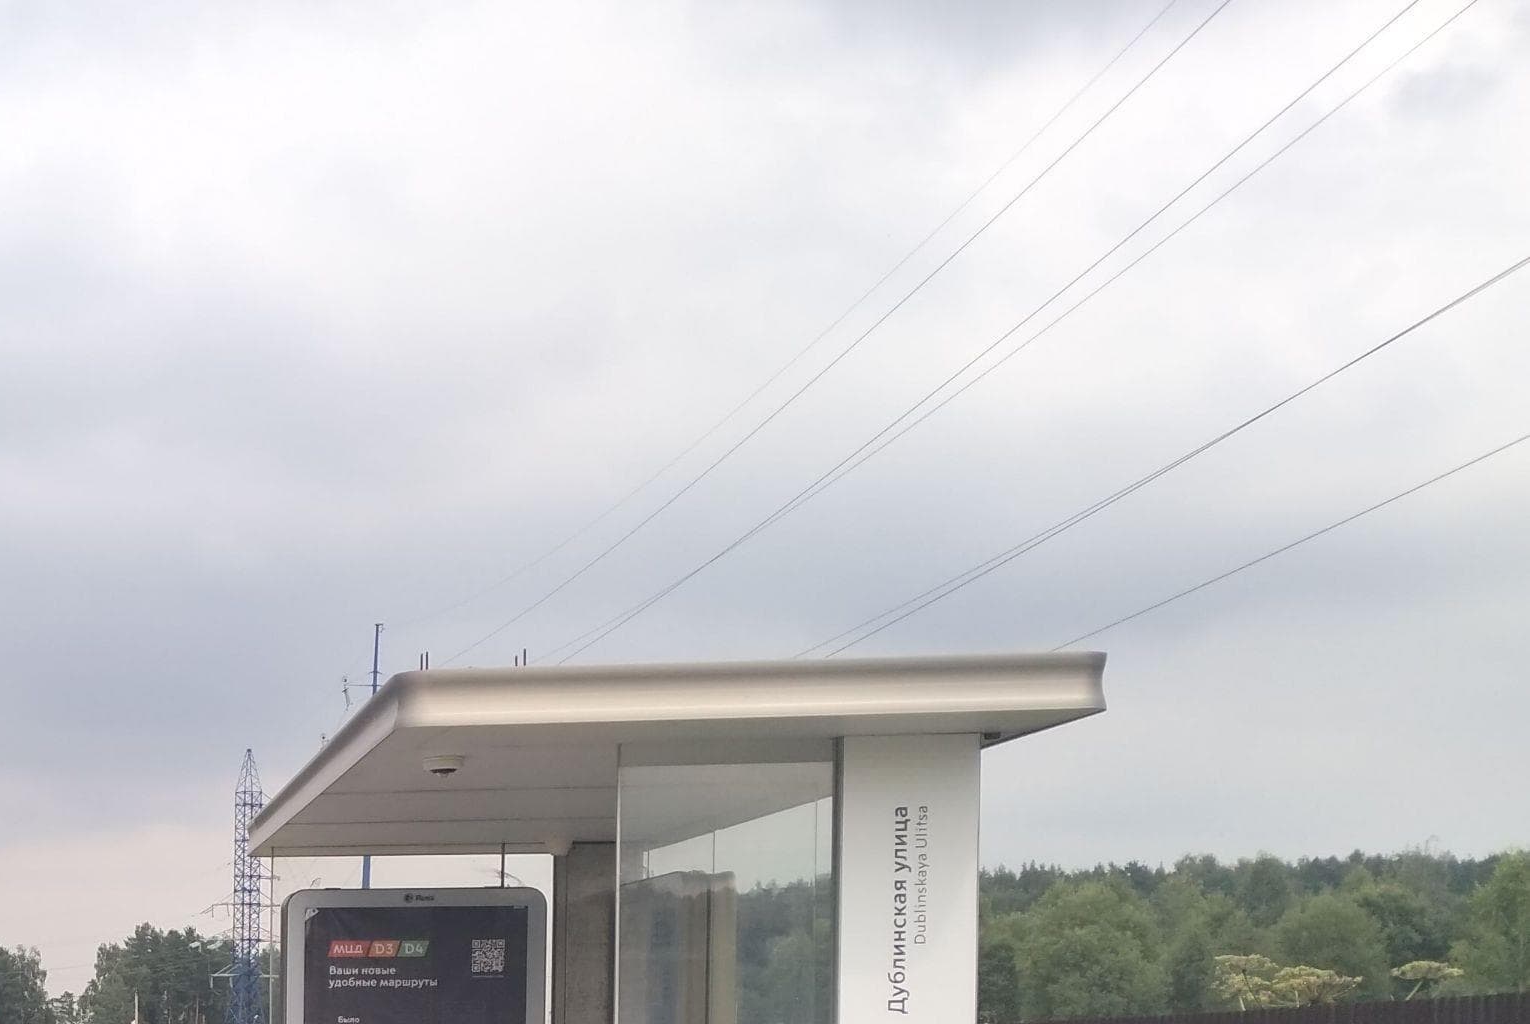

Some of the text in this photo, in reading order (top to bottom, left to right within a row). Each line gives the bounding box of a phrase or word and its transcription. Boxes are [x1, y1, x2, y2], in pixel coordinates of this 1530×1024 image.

[914, 805, 930, 945] Dublinskaya Ulitsa
[887, 806, 911, 1015] Дублинская улица
[333, 943, 424, 955] МЦД D3 D4
[329, 965, 397, 975] Ваши новые
[328, 977, 438, 989] удобные маршруты
